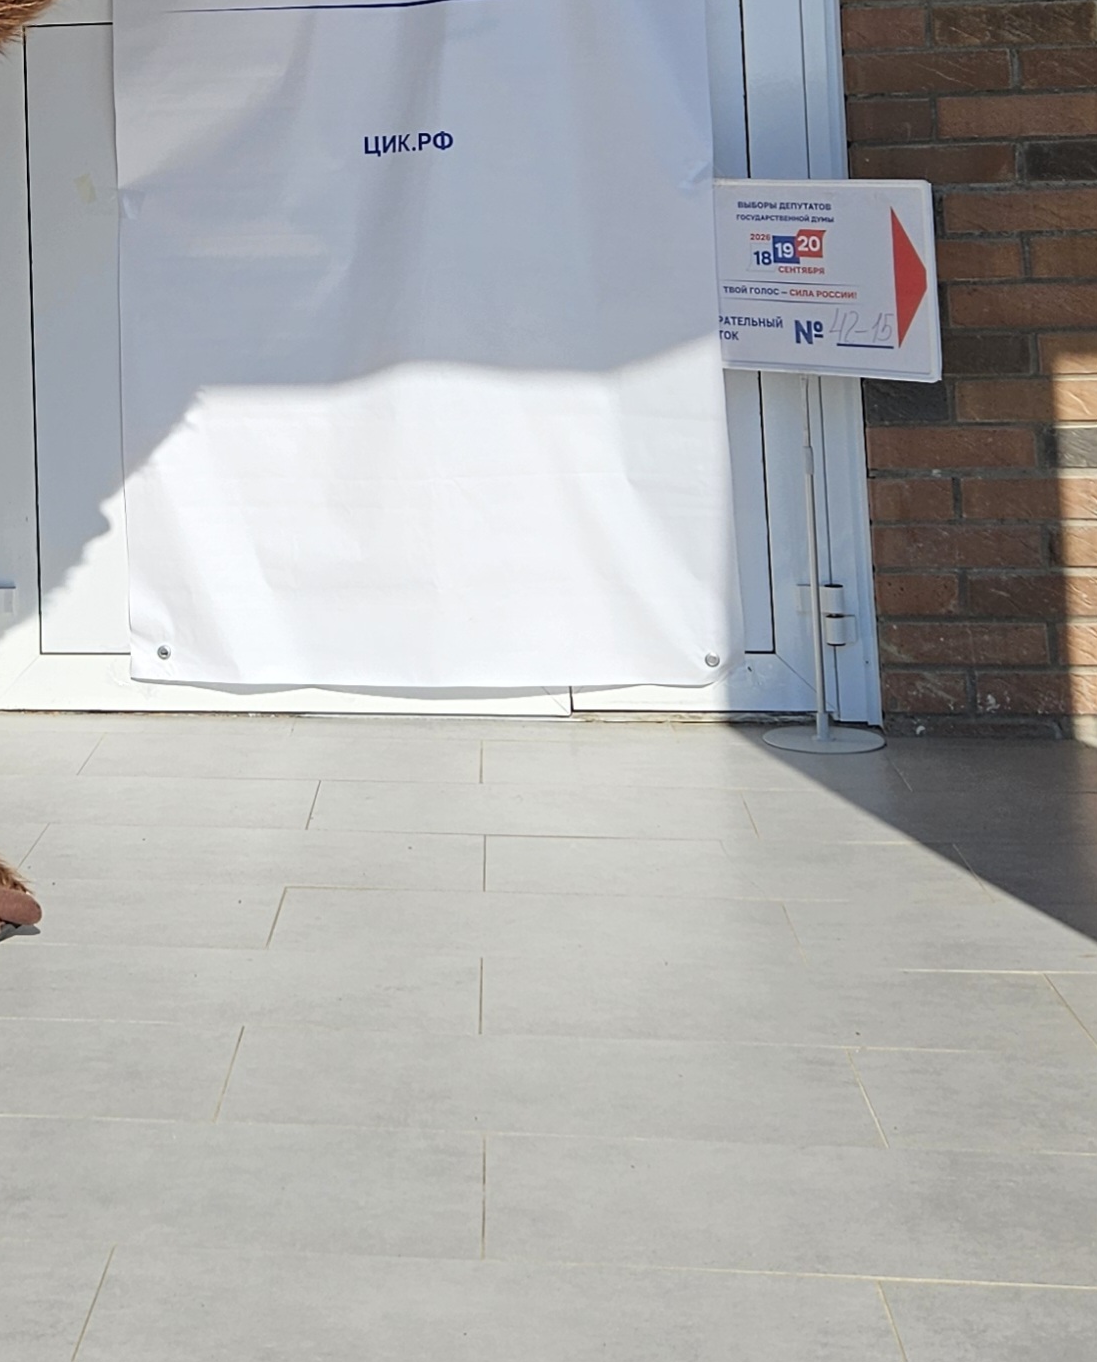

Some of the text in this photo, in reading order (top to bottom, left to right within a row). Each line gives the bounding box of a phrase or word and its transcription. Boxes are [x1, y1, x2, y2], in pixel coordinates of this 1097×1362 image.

[364, 131, 454, 156] ЦИК.РФ
[737, 201, 832, 211] ВЫБОРЫ ДЕПУТАТОВ
[736, 214, 835, 223] ГОСУДАРСТВЕННОЙ ДУМЫ
[750, 233, 771, 241] 2026
[753, 235, 821, 266] 18 19 20
[778, 266, 825, 275] СЕНТЯБРЯ
[723, 285, 748, 295] ТВОЙ
[749, 287, 779, 296] ГОЛОС
[789, 288, 814, 298] СИЛА
[816, 290, 858, 299] РОССИИ!
[719, 315, 783, 329] РАТЕЛЬНЫЙ
[719, 329, 740, 341] ТОК
